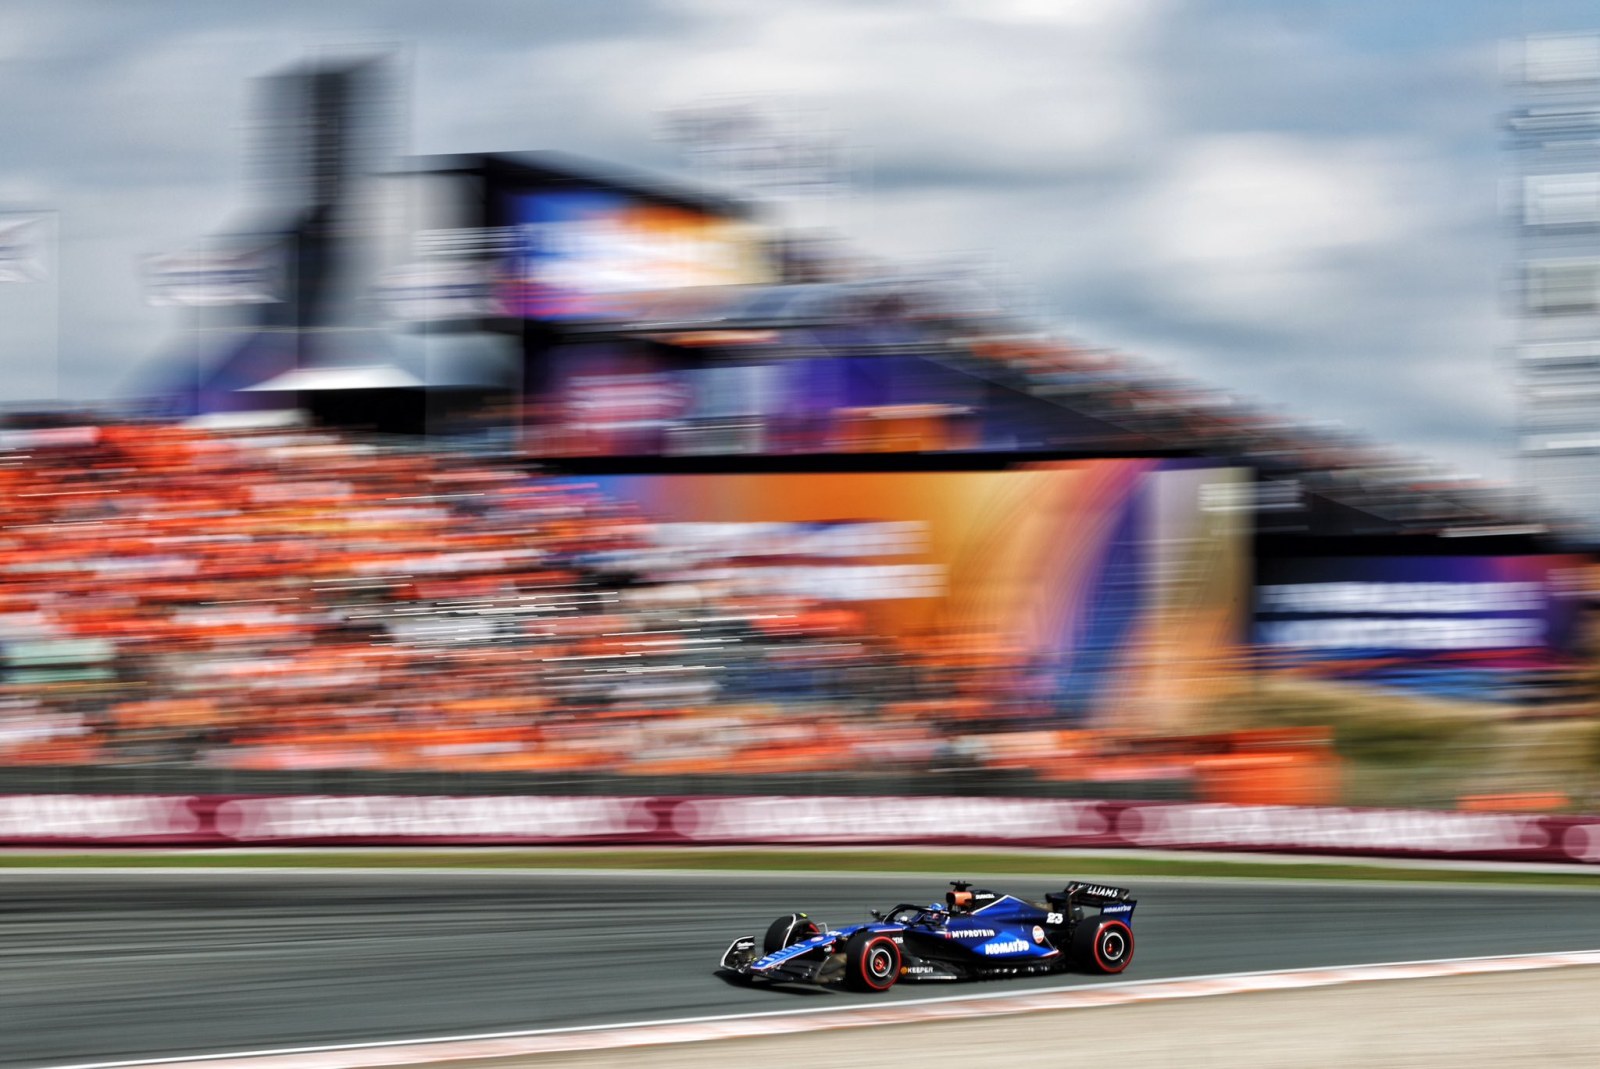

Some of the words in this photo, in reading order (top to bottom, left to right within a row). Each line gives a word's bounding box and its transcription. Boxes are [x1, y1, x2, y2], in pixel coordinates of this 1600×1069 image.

[1077, 883, 1118, 898] LLIAMS
[1046, 912, 1064, 925] 23
[951, 929, 995, 938] MYPROTEIN
[985, 938, 1029, 955] KOMATSU
[907, 966, 934, 974] KEEPER
